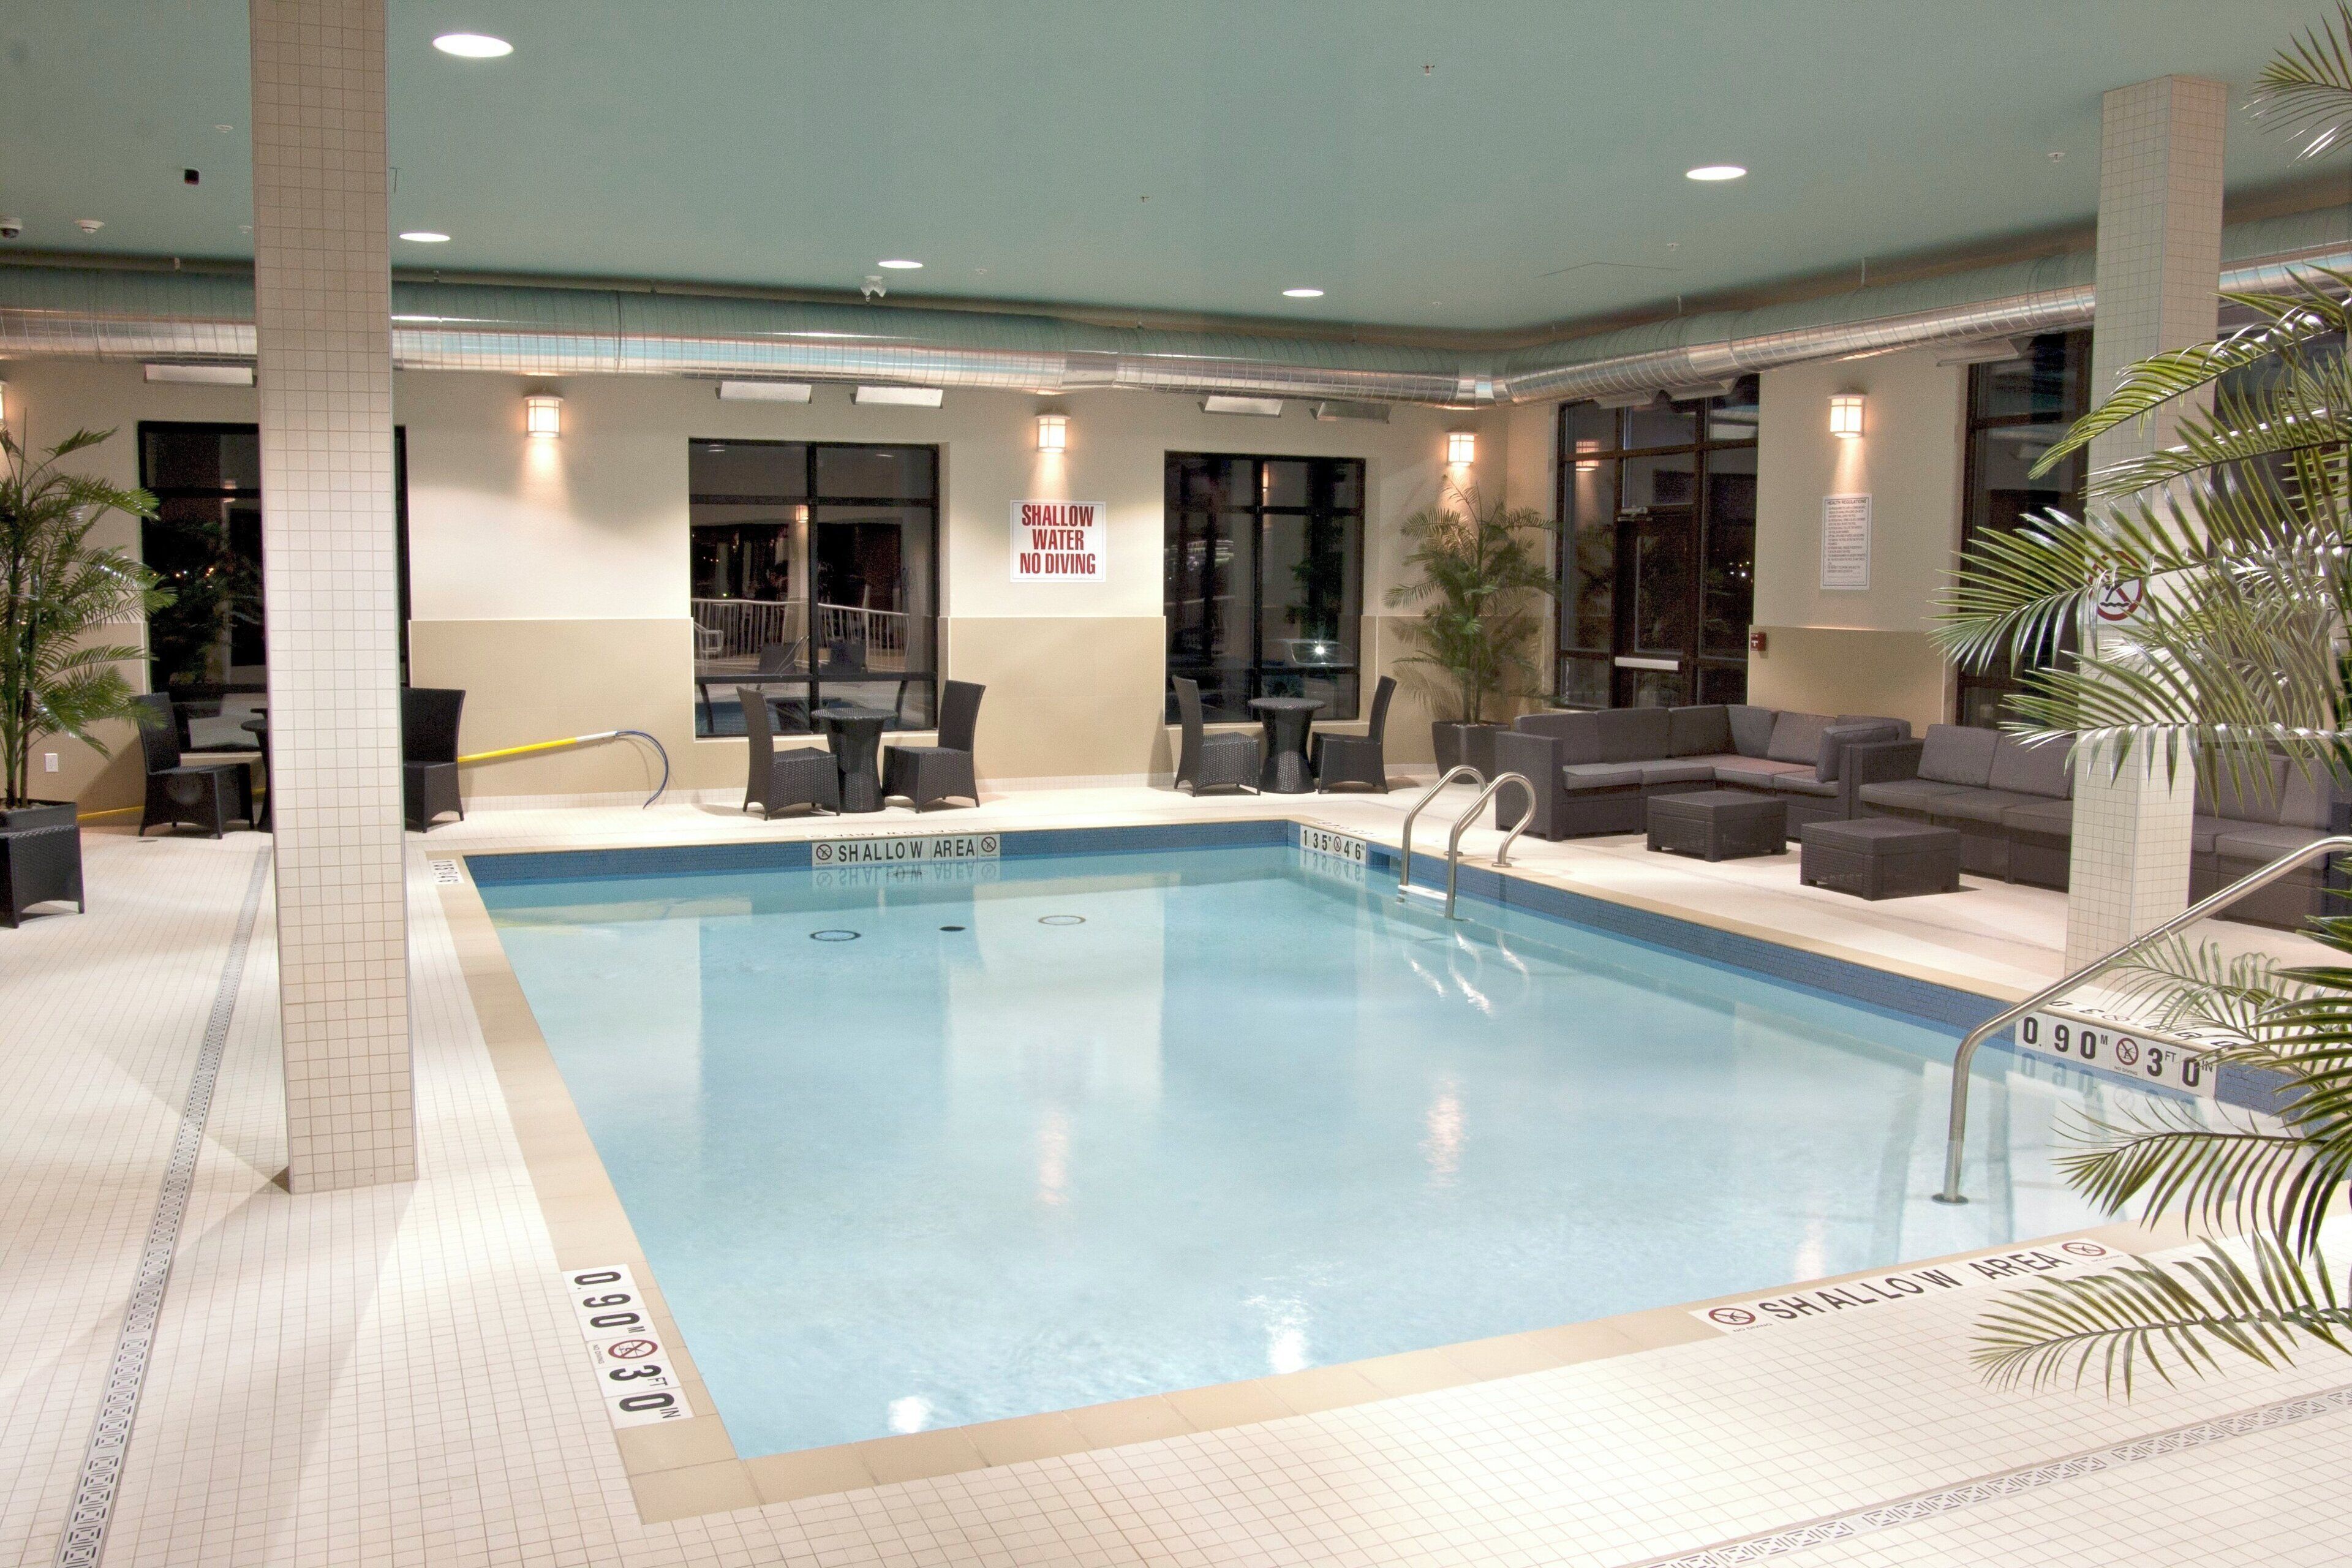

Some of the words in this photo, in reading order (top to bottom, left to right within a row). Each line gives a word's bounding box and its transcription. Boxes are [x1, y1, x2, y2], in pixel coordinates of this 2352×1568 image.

[1022, 504, 1095, 527] SHALLOW
[1032, 529, 1084, 550] WATER
[1020, 552, 1041, 574] NO
[1045, 553, 1096, 575] DIVING
[839, 841, 922, 862] SHALLOW
[933, 839, 974, 858] AREA
[1758, 1269, 1962, 1319] SHALLOW
[1969, 1251, 2072, 1280] AREA
